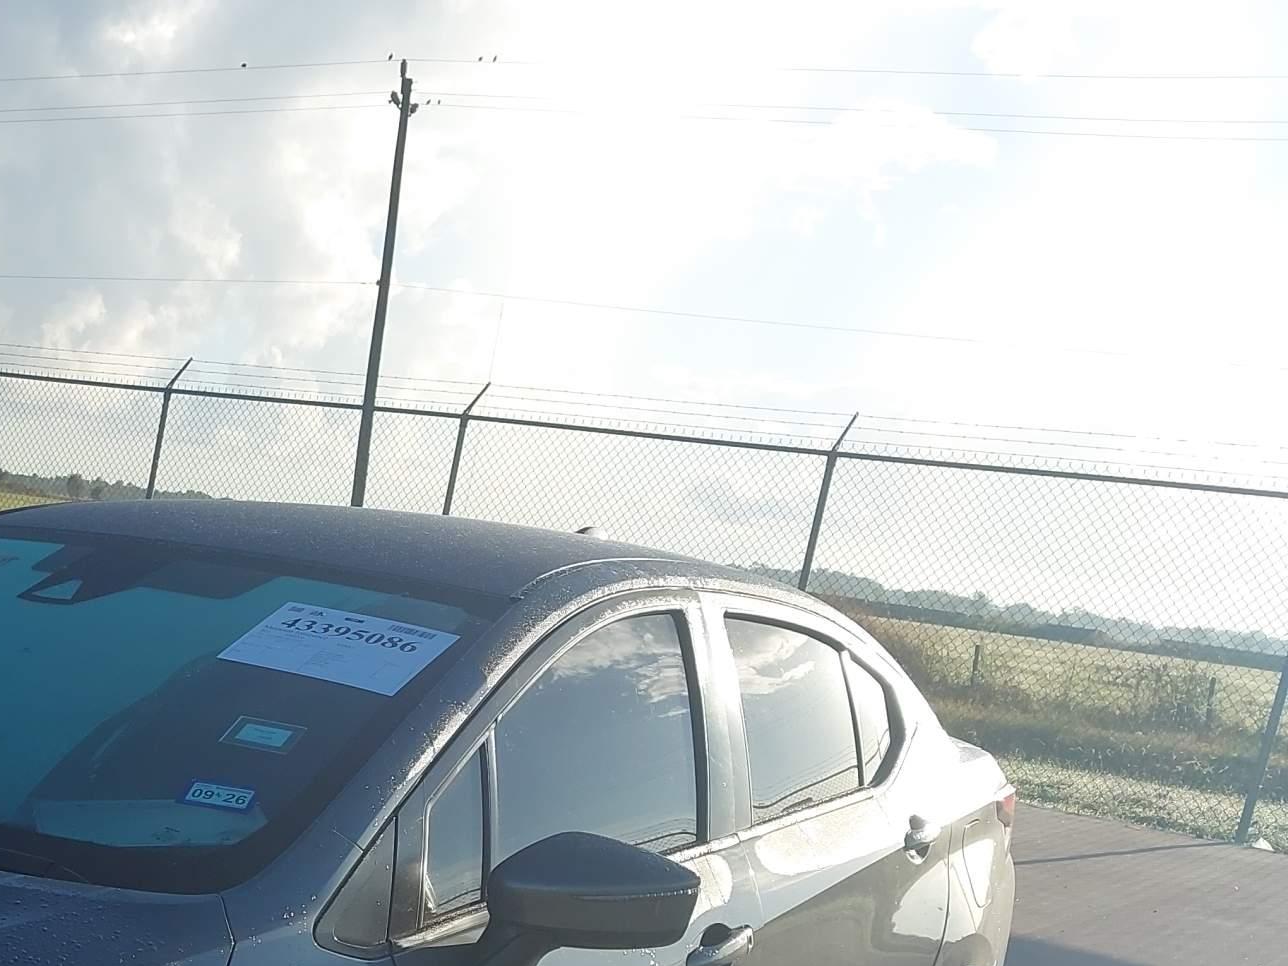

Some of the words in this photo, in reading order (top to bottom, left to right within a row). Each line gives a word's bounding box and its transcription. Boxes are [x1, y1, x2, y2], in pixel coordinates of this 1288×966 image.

[281, 616, 419, 653] 43395086
[191, 788, 215, 800] 09
[222, 793, 248, 805] 26
